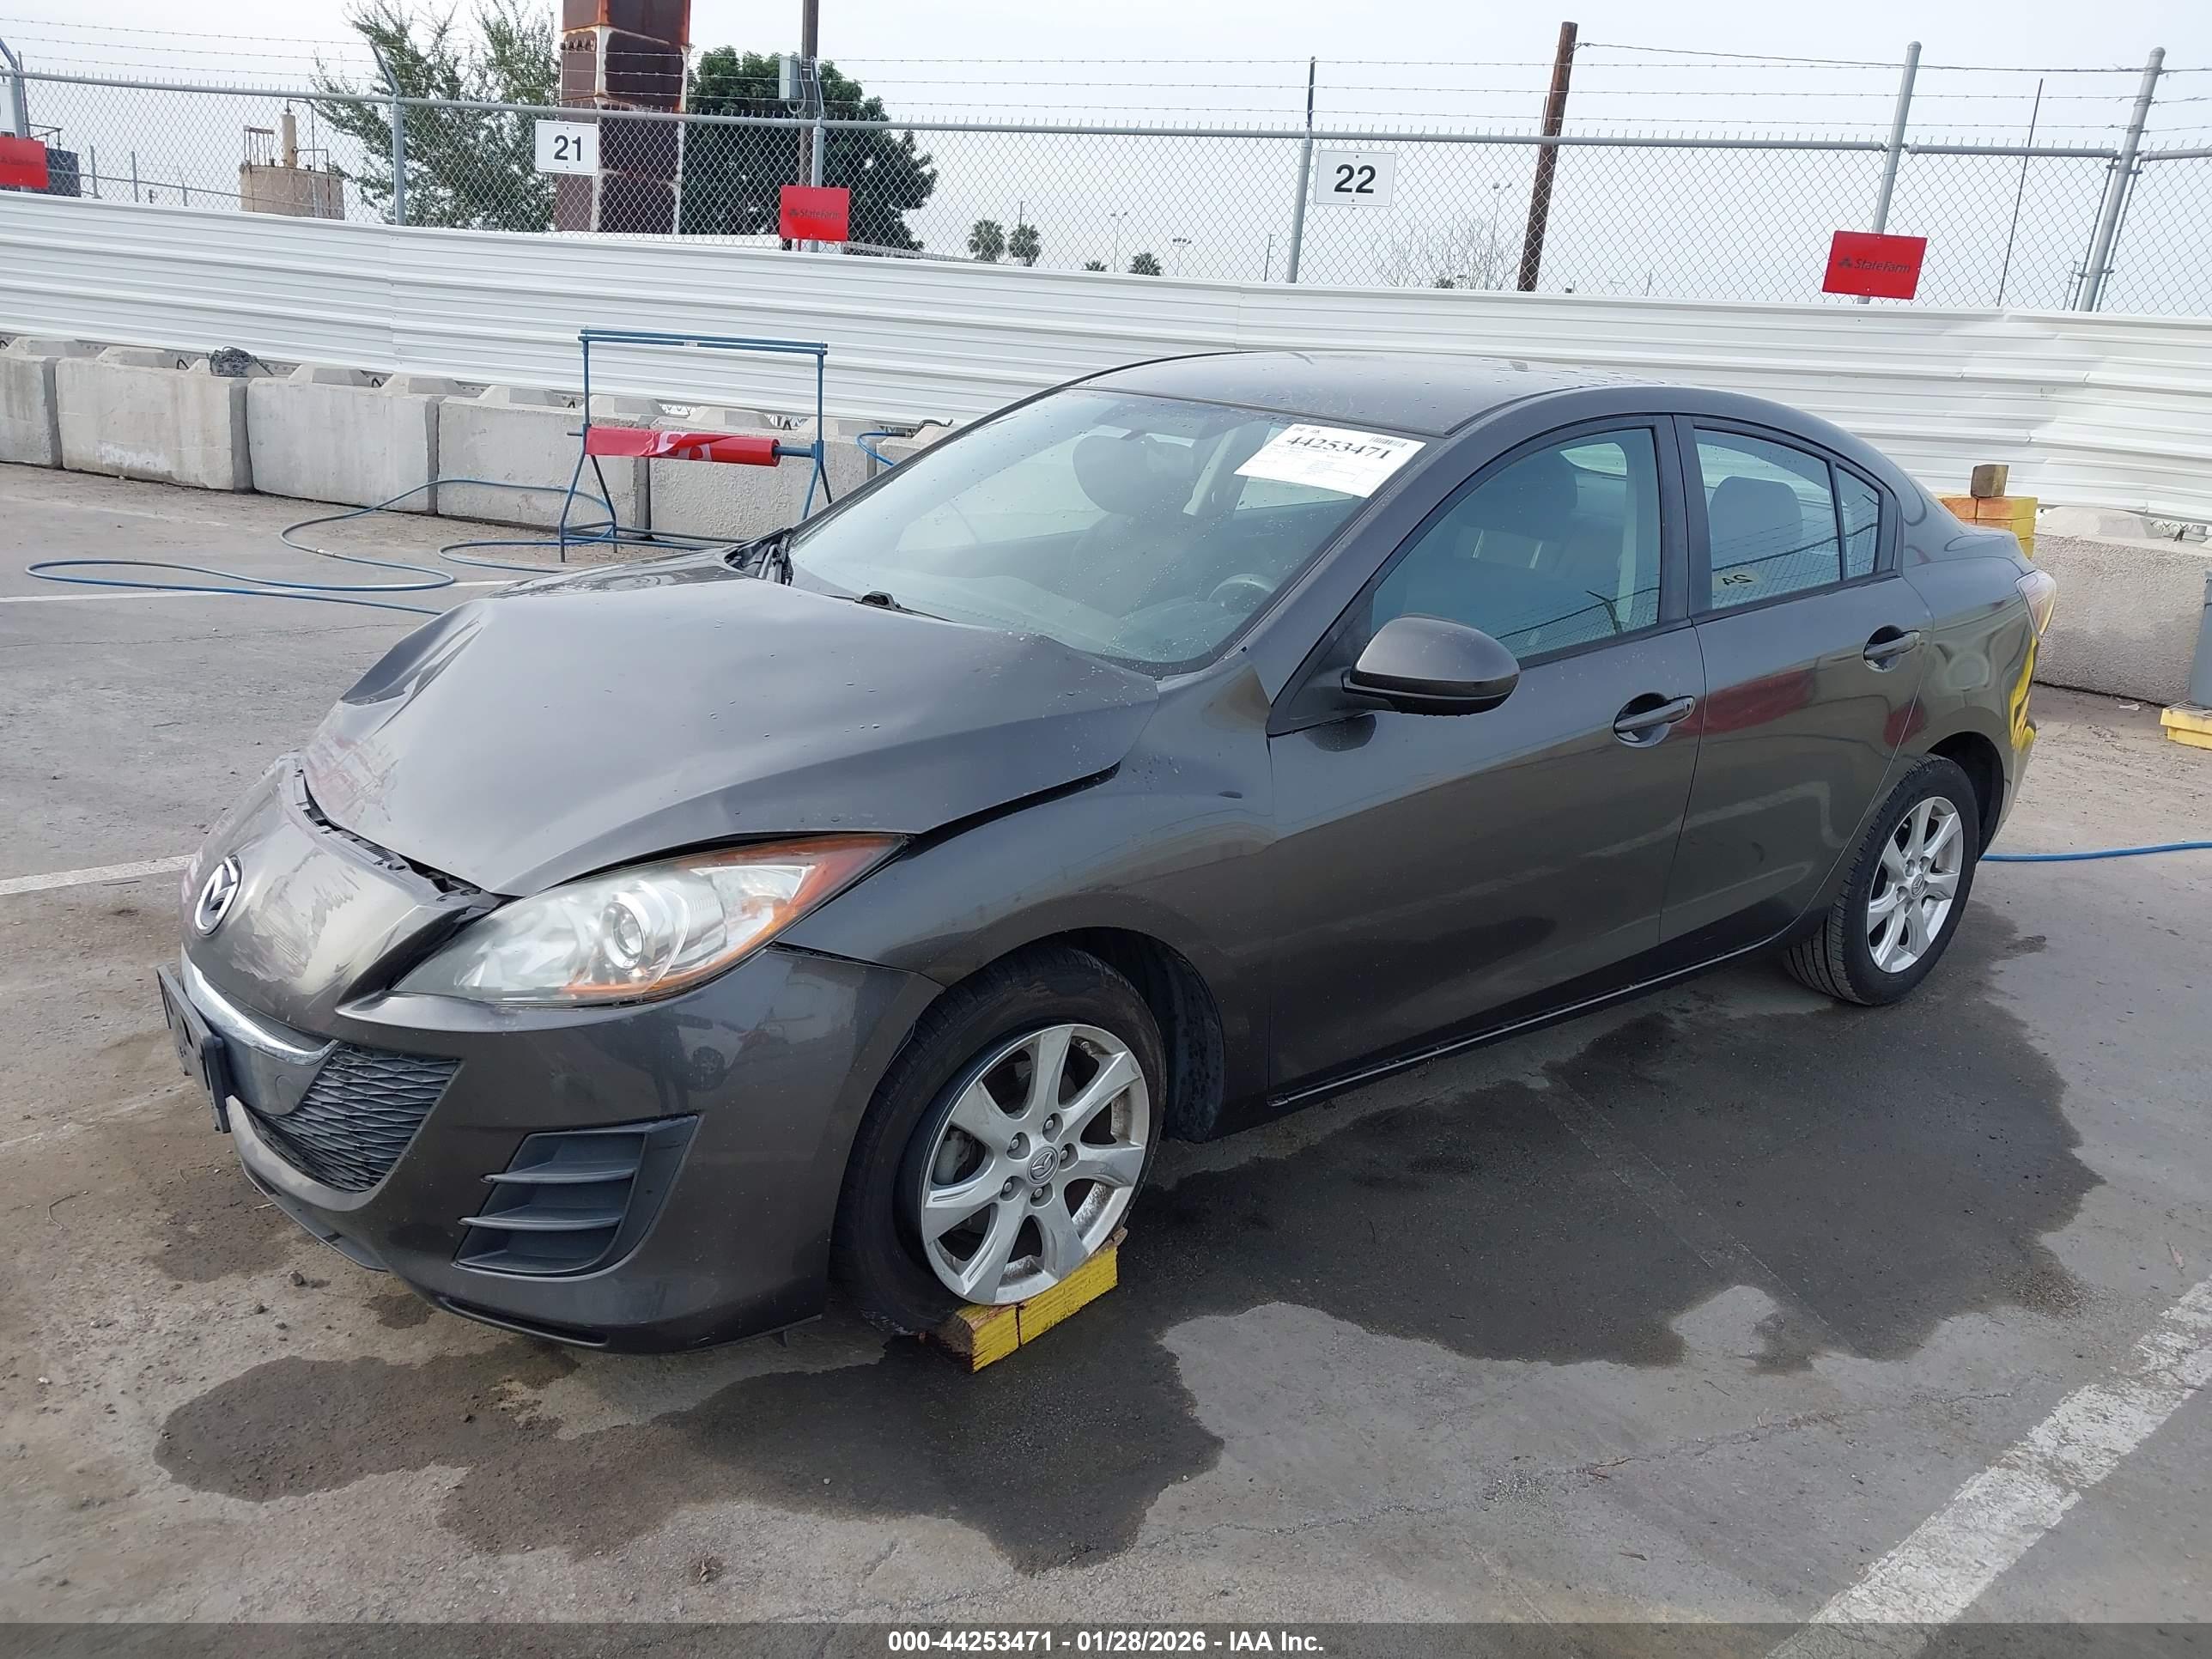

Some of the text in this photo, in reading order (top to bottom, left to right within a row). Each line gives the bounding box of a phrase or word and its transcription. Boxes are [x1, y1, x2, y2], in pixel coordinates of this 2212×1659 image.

[554, 135, 581, 161] 21
[1334, 164, 1376, 194] 22
[1286, 436, 1393, 459] 44253471
